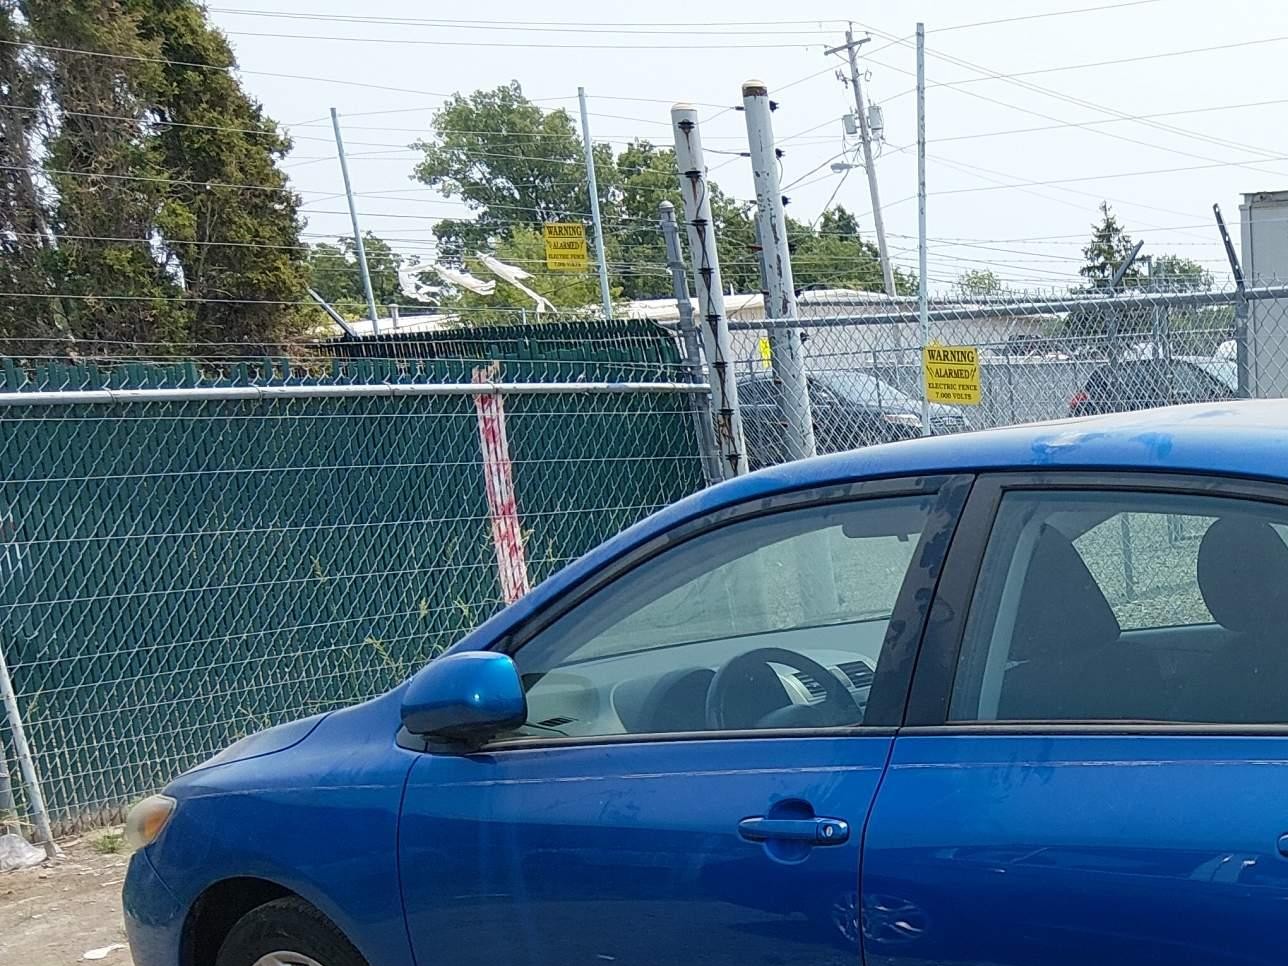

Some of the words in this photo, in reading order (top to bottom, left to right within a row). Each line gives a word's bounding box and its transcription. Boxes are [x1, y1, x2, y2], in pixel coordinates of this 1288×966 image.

[546, 225, 582, 236] WARNING
[927, 349, 975, 362] WARNING
[934, 367, 970, 379] ALARMED
